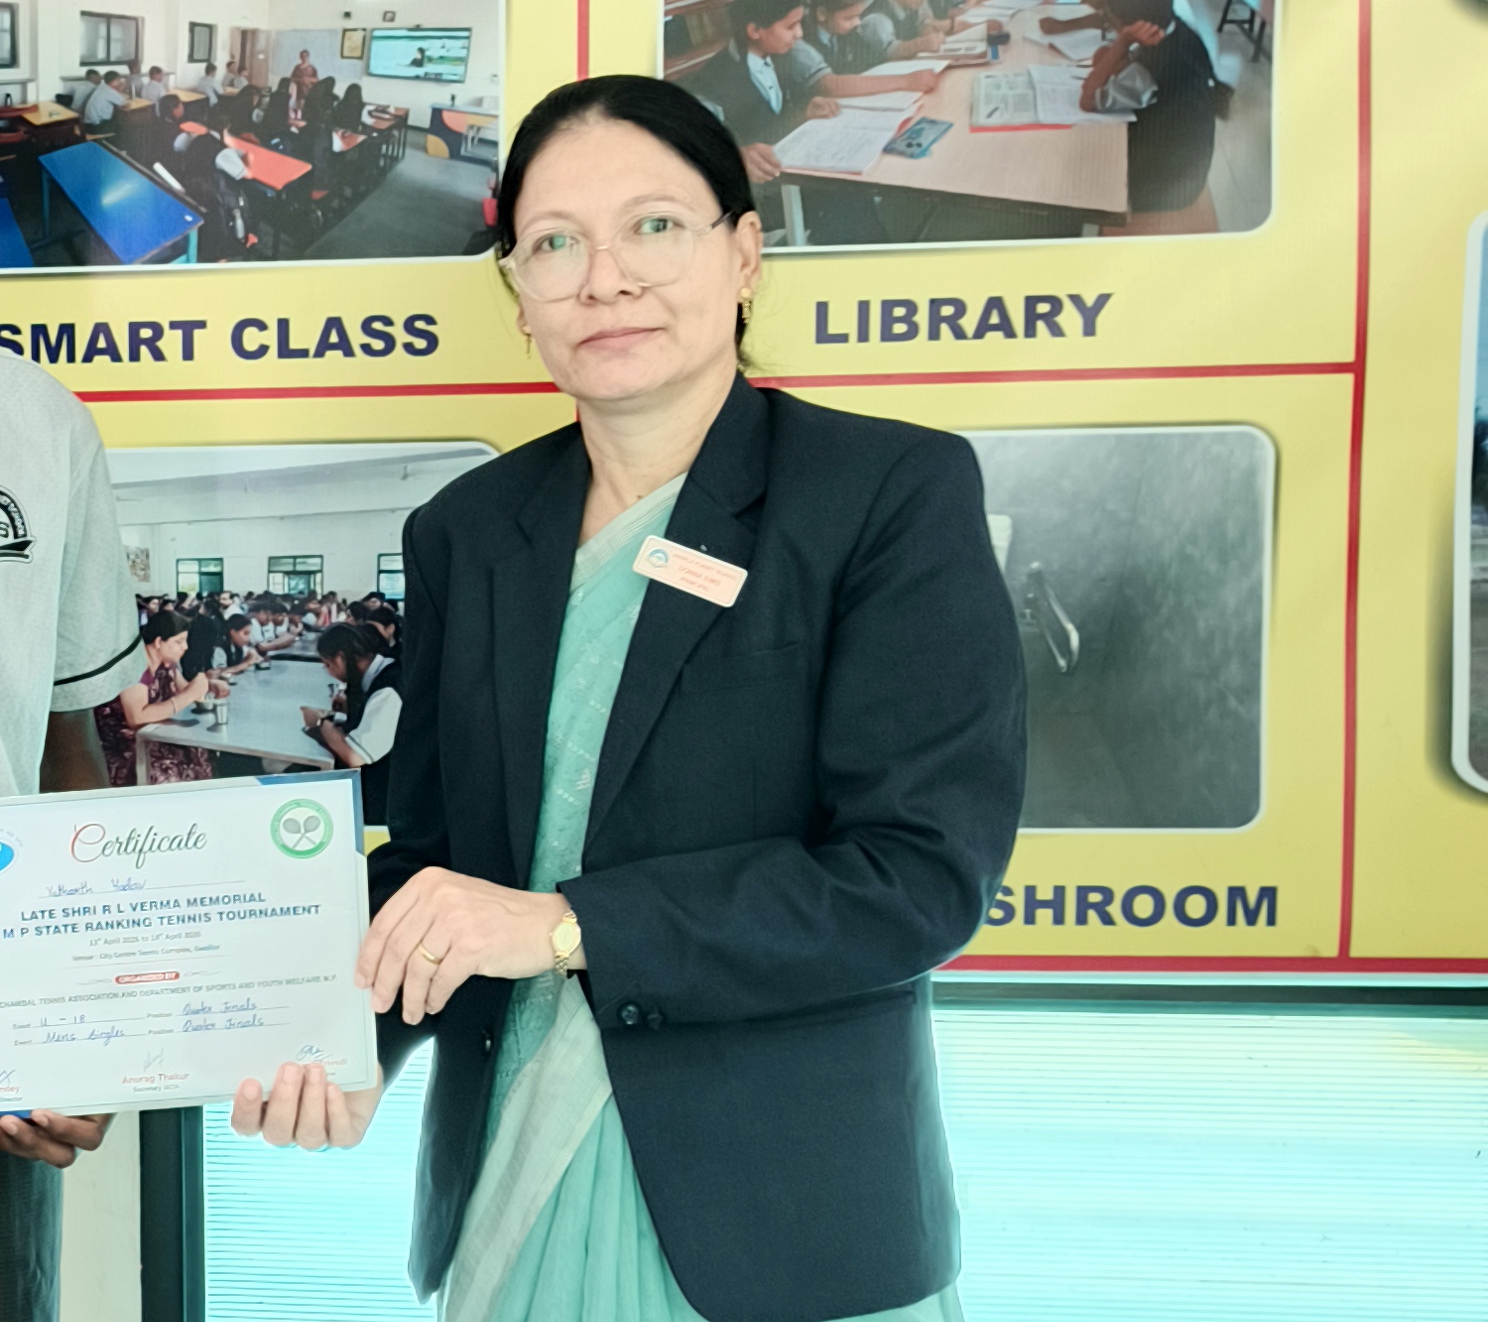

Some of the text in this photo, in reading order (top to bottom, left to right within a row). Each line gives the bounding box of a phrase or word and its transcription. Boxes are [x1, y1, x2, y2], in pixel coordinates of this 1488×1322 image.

[231, 314, 437, 360] CLASS
[816, 294, 1109, 344] LIBRARY
[70, 822, 207, 870] Certificate
[3, 928, 15, 940] M
[20, 927, 30, 938] P
[34, 922, 80, 937] STATE
[84, 917, 153, 932] RANKING
[157, 912, 212, 927] TENNIS
[216, 904, 322, 922] TOURNAMENT
[20, 892, 267, 922] LATE SHRI R L VERMA MEMORIAL
[983, 884, 1279, 927] SHROOM
